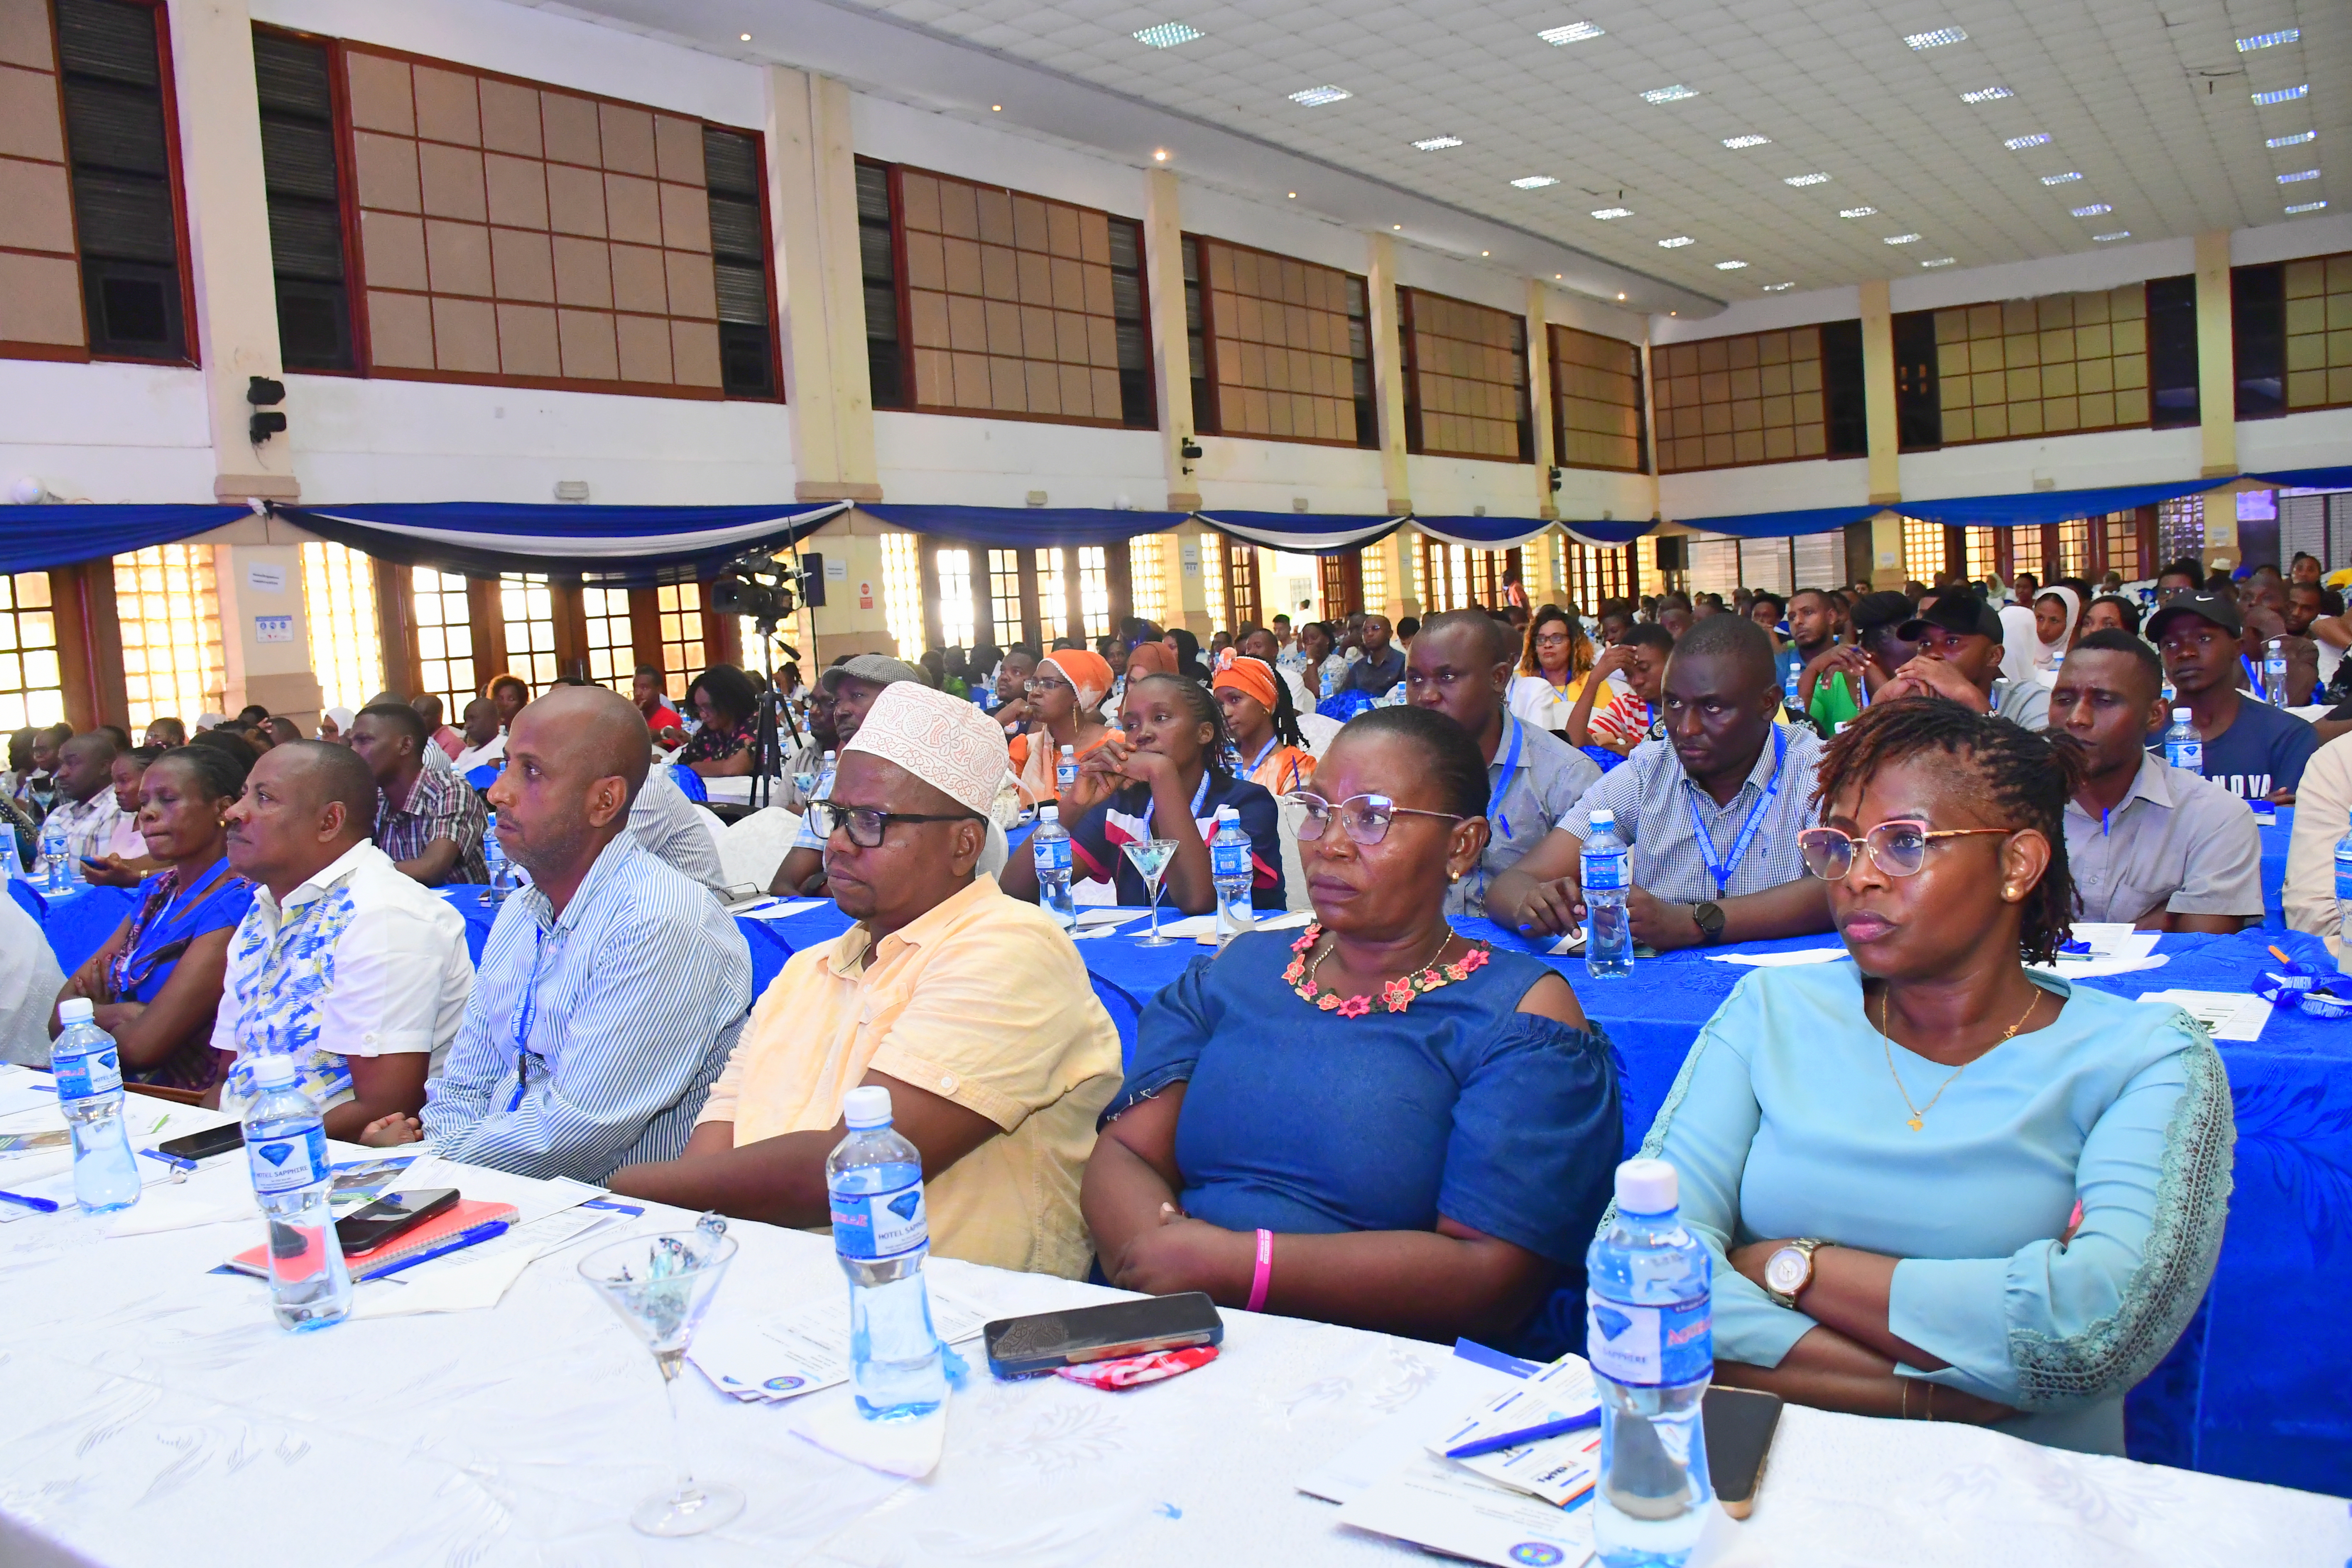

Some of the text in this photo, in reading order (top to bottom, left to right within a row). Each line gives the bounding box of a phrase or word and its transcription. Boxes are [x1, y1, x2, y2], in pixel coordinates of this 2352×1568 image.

[2199, 774, 2271, 798] NOVA
[1731, 847, 1744, 862] PORTS
[1746, 811, 1764, 832] SUPPLIERS
[513, 1008, 523, 1022] PORTS
[525, 1009, 534, 1024] PORTS
[93, 1075, 109, 1083] HOTEL
[274, 1165, 309, 1177] SAPPHIRE
[878, 1230, 902, 1240] HOTEL
